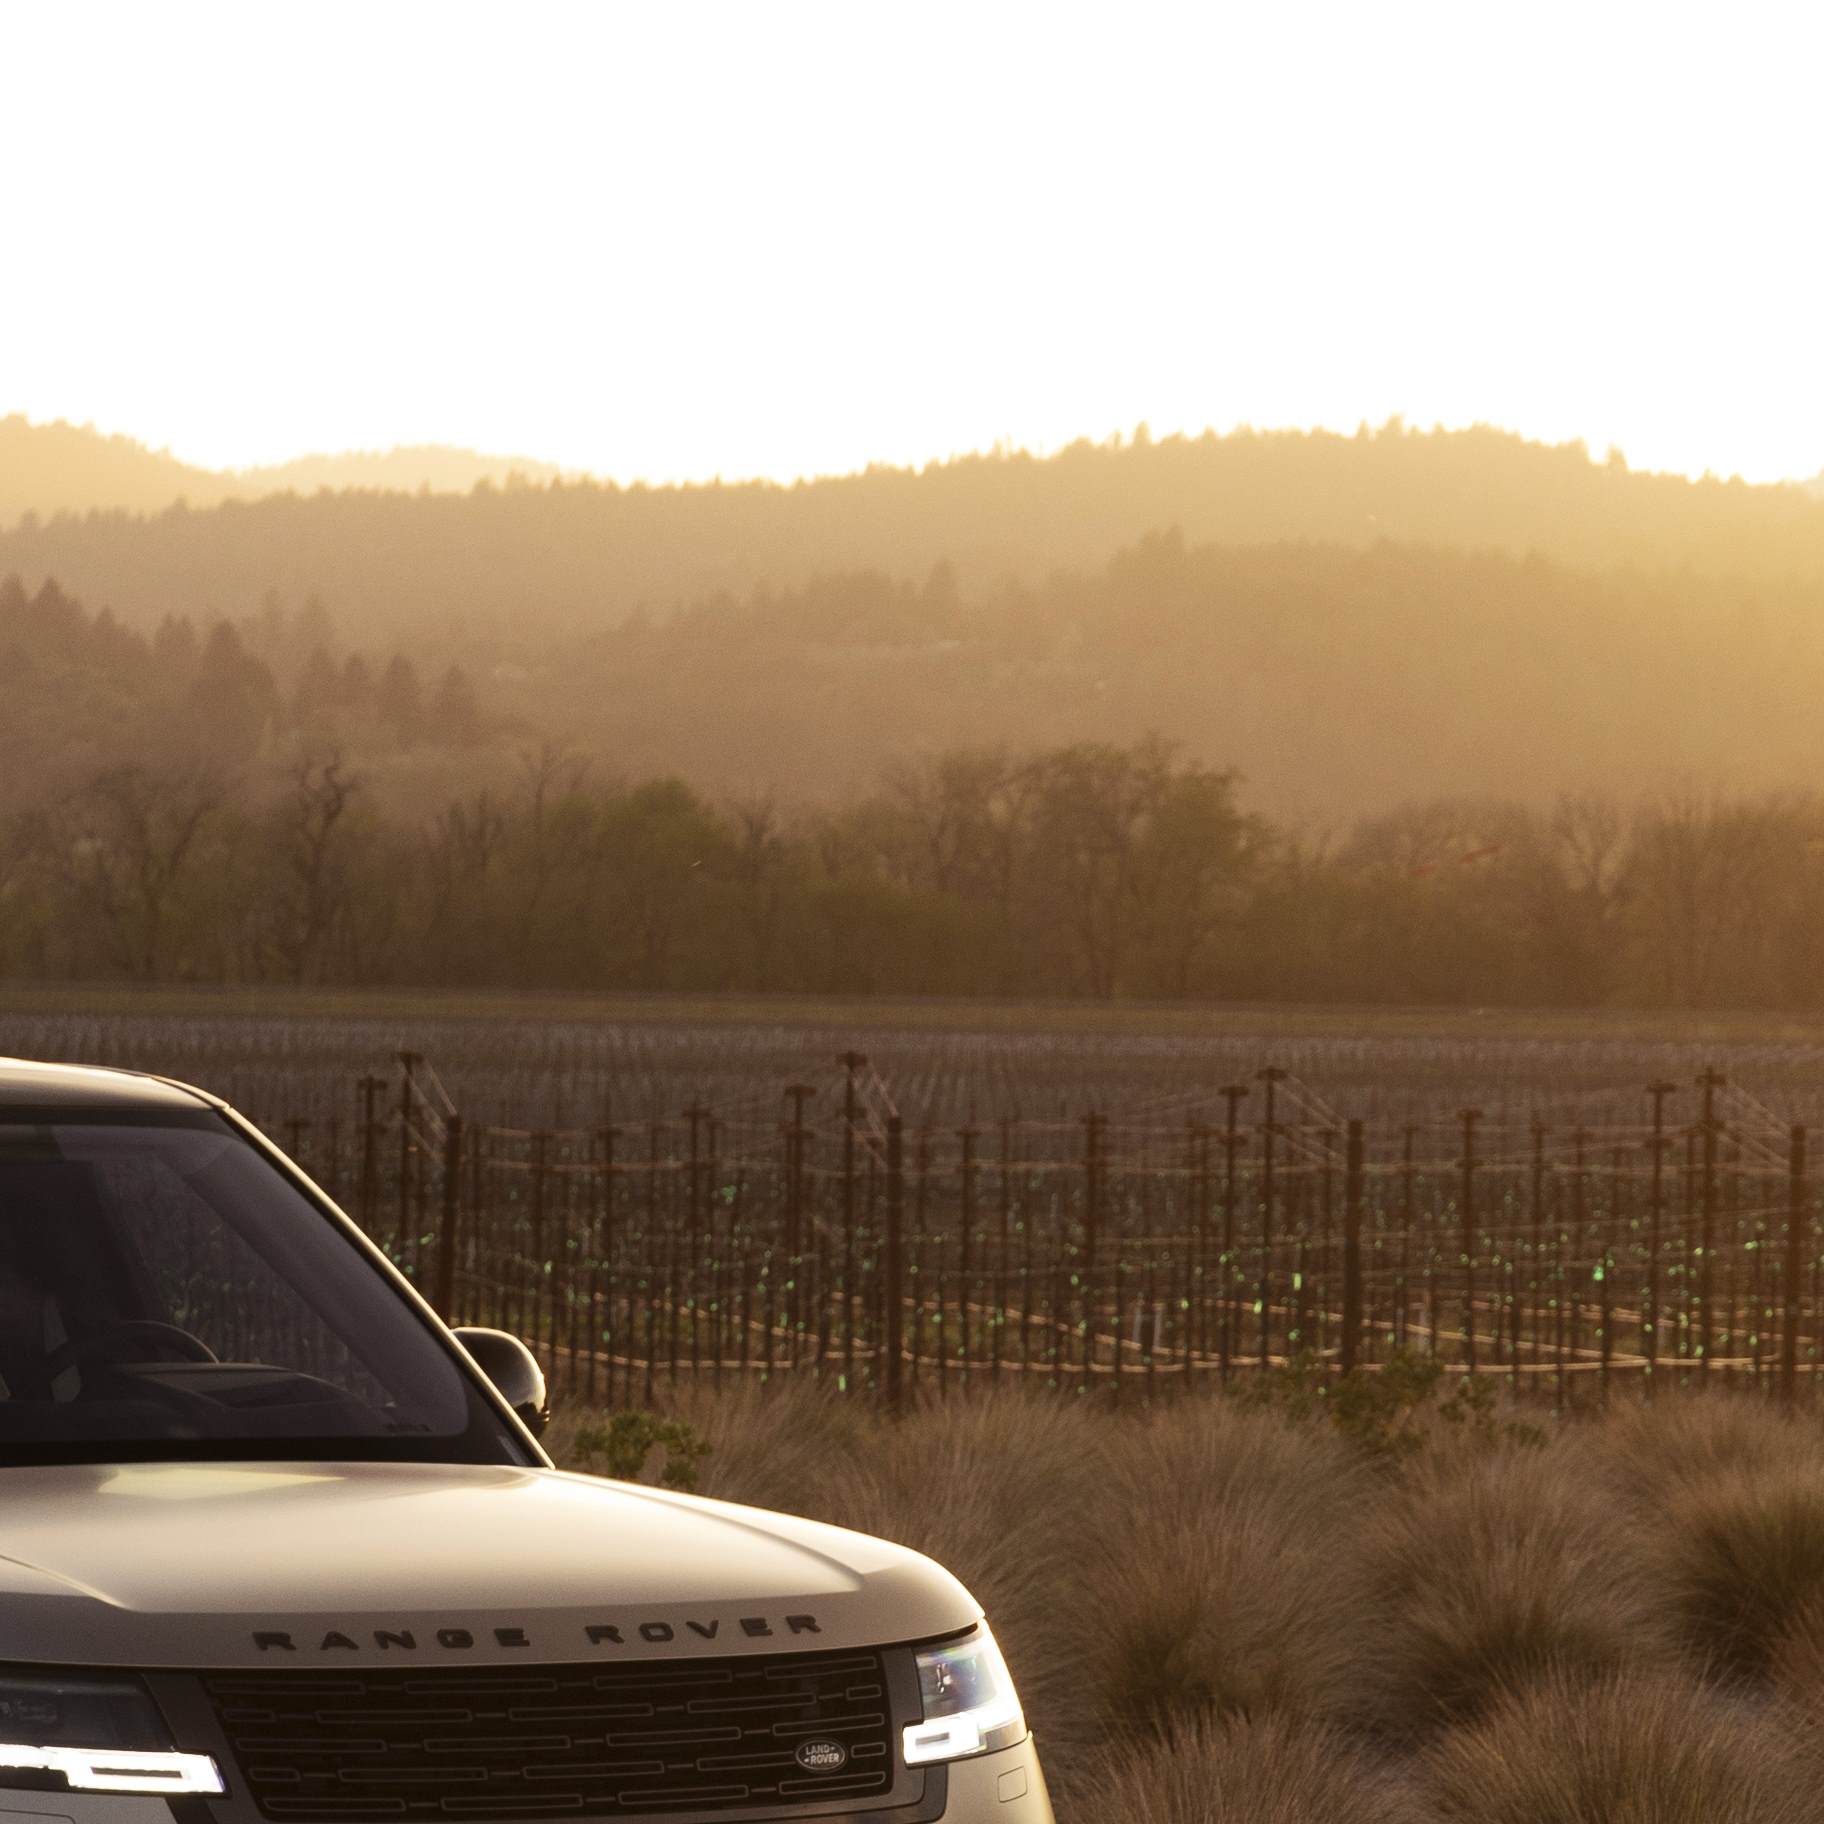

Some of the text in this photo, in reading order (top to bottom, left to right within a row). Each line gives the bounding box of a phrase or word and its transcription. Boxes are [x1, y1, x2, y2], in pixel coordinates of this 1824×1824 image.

[251, 1614, 823, 1652] RANGE ROVER
[806, 1744, 830, 1755] LAND
[810, 1752, 839, 1765] ROVER
